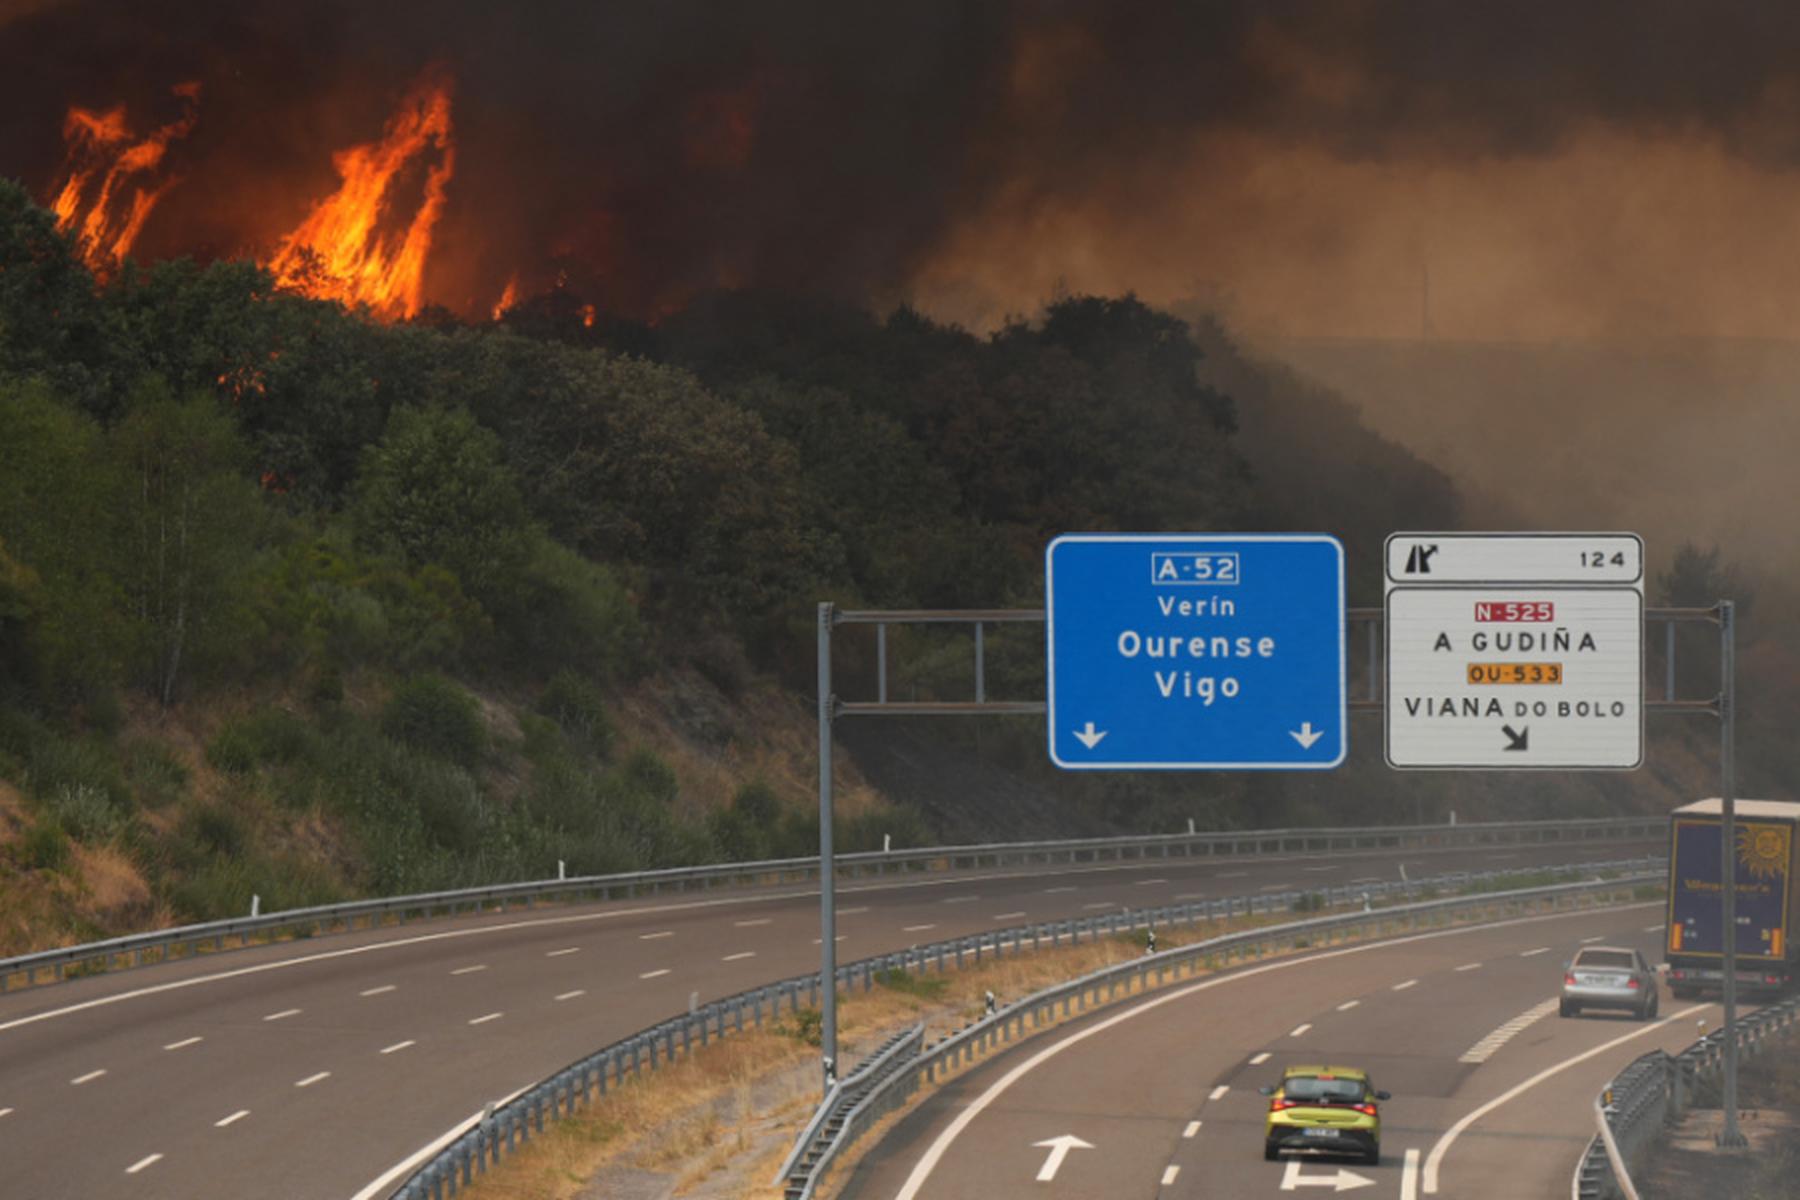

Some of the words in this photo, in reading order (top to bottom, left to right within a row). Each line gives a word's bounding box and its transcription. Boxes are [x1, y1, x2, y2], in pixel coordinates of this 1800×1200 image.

[1157, 557, 1235, 580] A-52
[1580, 551, 1625, 568] 124
[1157, 595, 1236, 616] Verín
[1476, 603, 1552, 621] N-525
[1117, 629, 1275, 658] Ourense
[1433, 632, 1452, 652] A
[1471, 627, 1597, 652] GUDIÑA
[1470, 665, 1560, 682] OU-533
[1154, 671, 1240, 706] Vigo
[1404, 697, 1504, 717] VIANA
[1514, 701, 1547, 717] DO
[1557, 701, 1625, 717] BOLO
